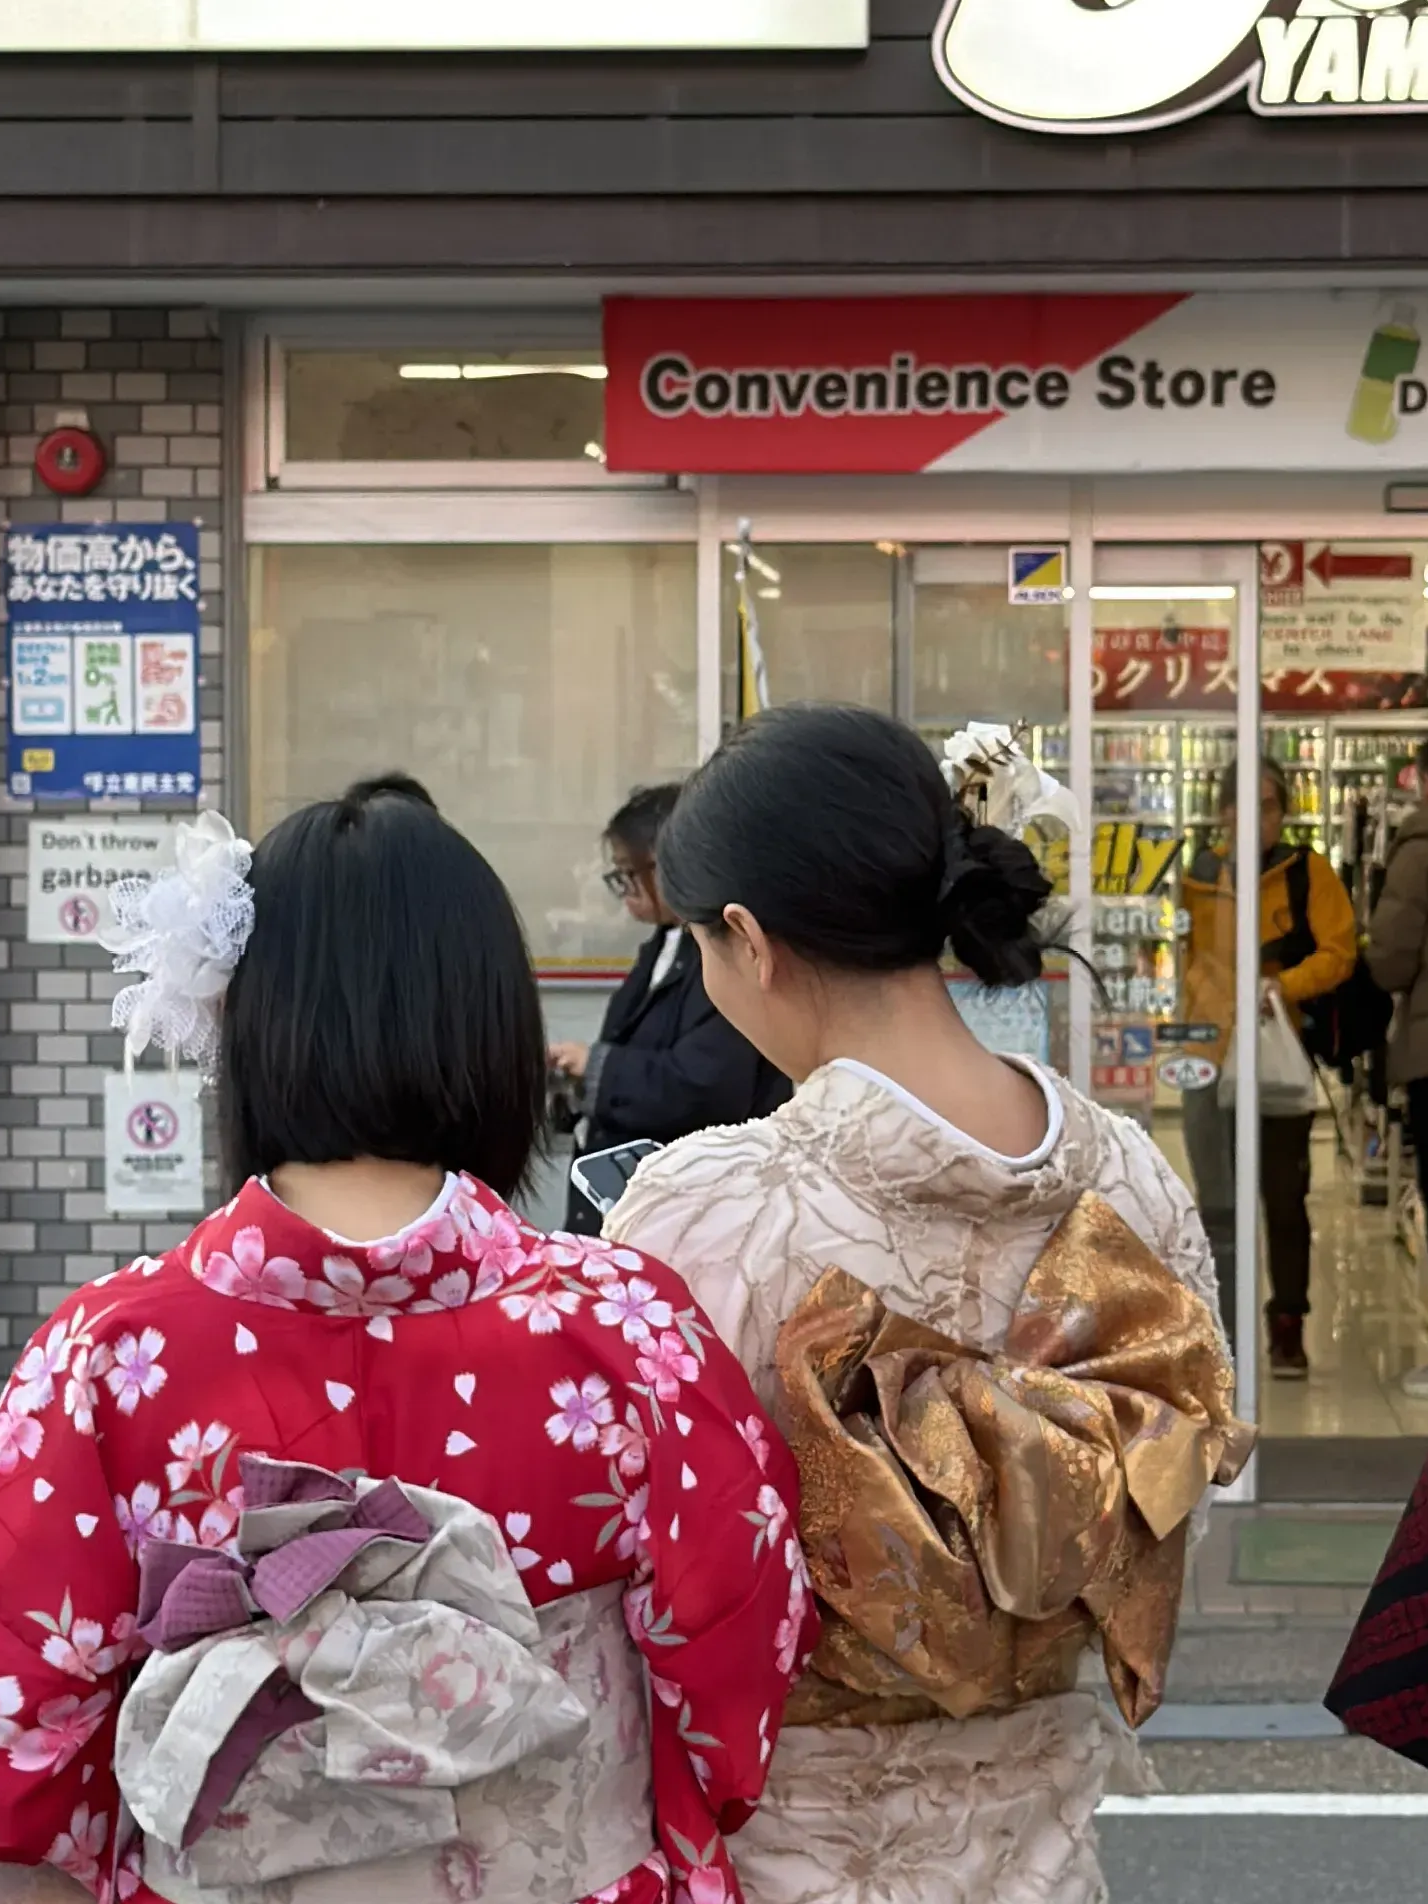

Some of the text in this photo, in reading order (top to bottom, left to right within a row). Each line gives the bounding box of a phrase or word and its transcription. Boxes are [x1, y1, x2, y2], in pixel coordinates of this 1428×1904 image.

[645, 354, 1277, 413] Convenience Store
[8, 532, 196, 573] 物価高から、
[8, 573, 198, 602] あなたを守り抜く
[101, 830, 159, 850] throw
